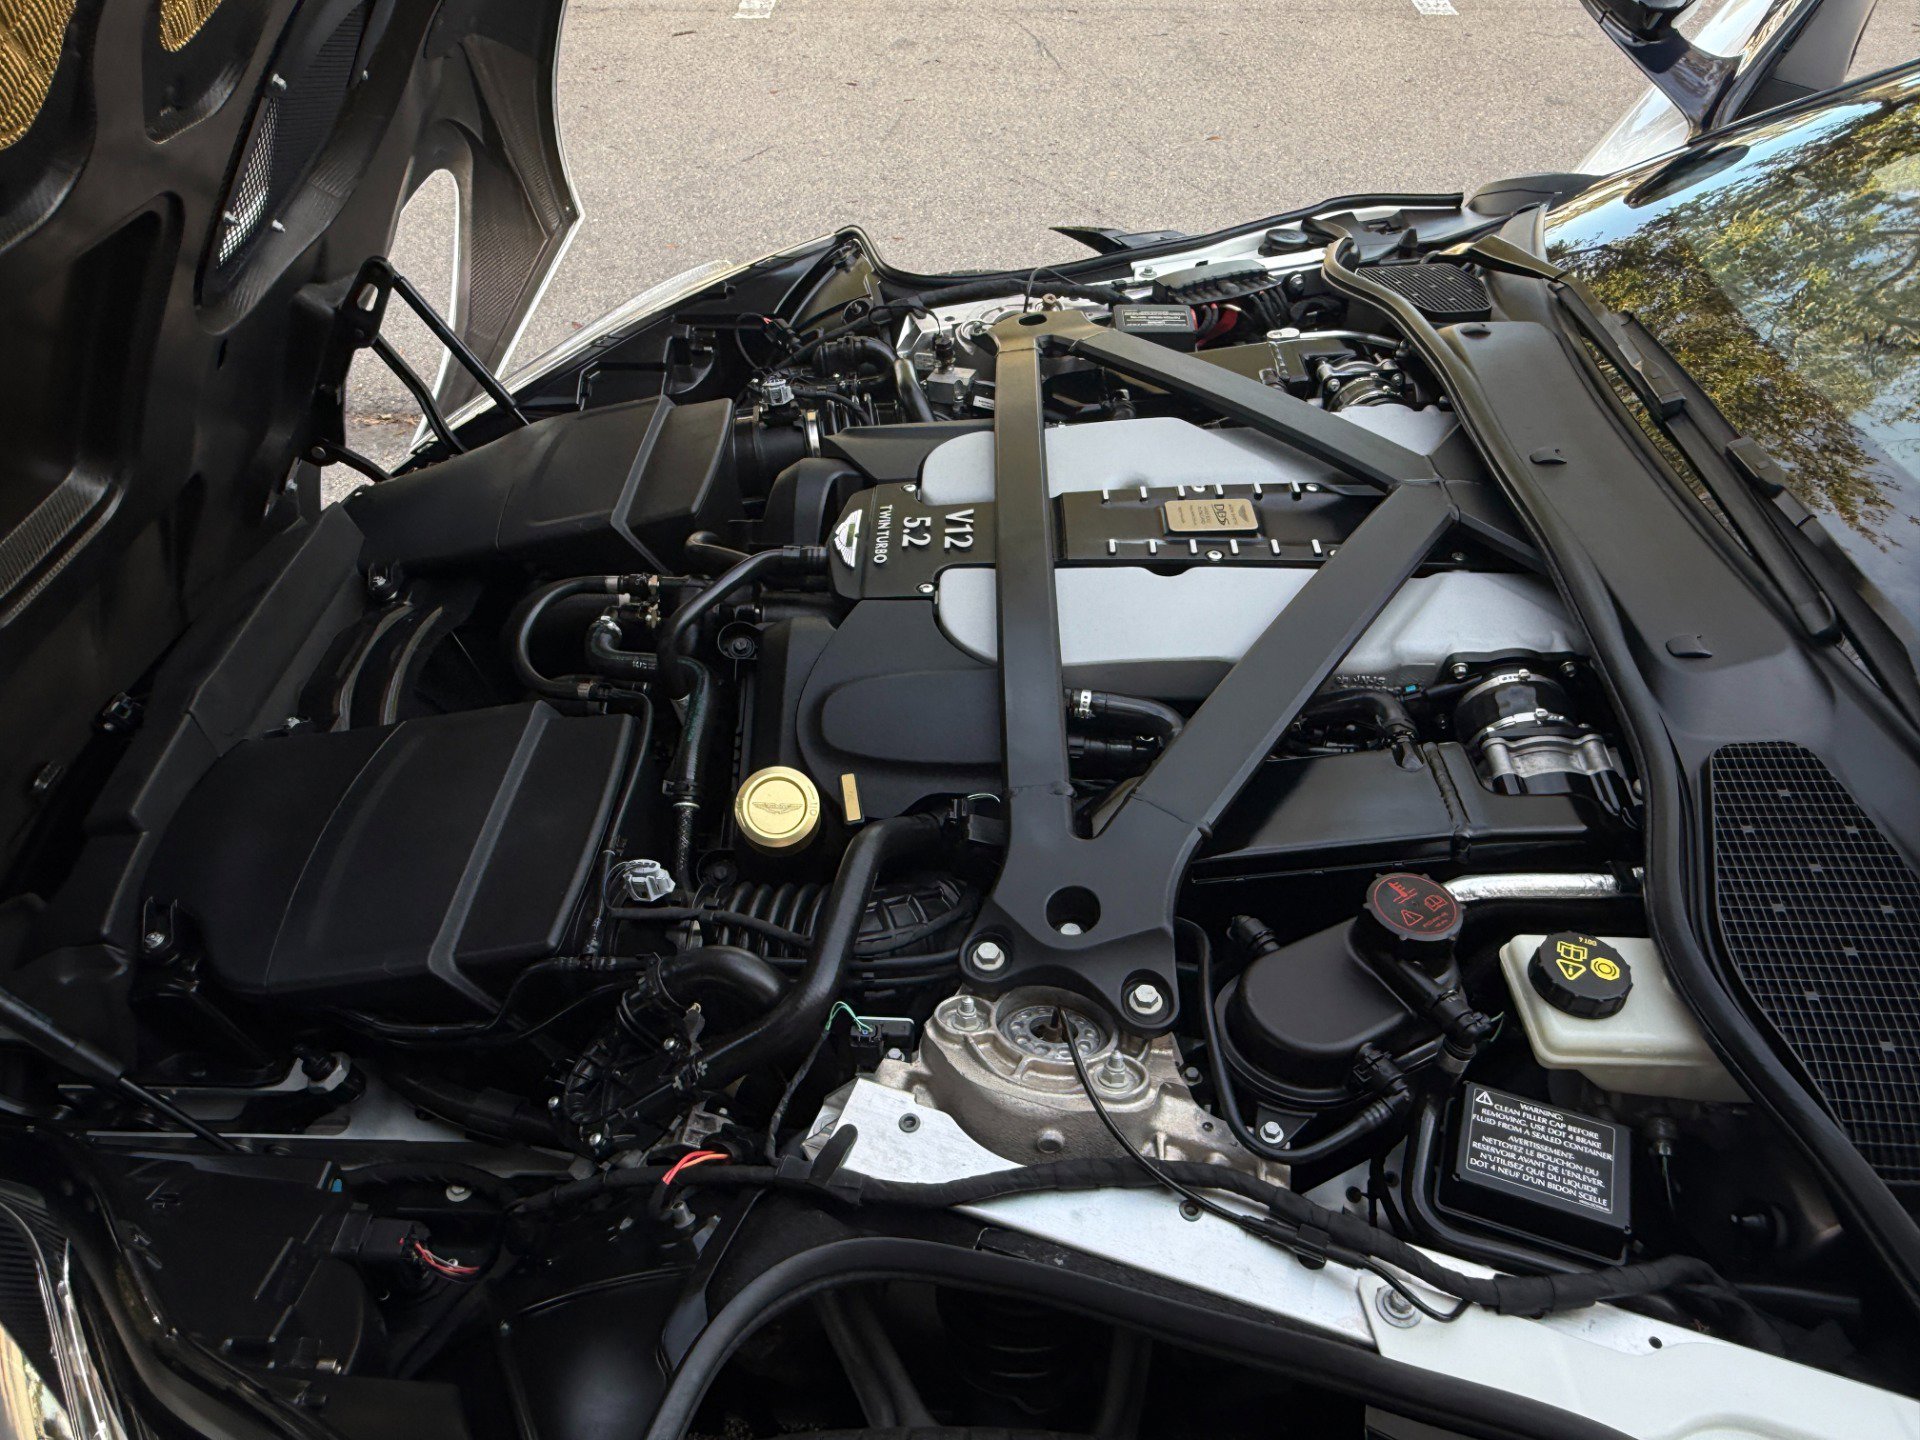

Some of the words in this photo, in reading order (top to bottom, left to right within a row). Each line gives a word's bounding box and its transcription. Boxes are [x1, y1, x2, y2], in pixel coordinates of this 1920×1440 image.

[877, 504, 893, 529] TWIN
[901, 516, 931, 548] 5.2
[944, 508, 975, 549] V12
[873, 530, 890, 564] TURBO
[1472, 1113, 1496, 1125] FLUID
[1497, 1121, 1522, 1133] FROM
[1531, 1131, 1562, 1145] SEALED
[1494, 1104, 1521, 1116] CLEAN
[1522, 1112, 1548, 1124] FILLER
[1549, 1120, 1566, 1130] CAP
[1568, 1125, 1599, 1140] BEFORE
[1530, 1122, 1545, 1133] USE
[1548, 1127, 1566, 1138] DOT
[1575, 1136, 1602, 1149] BRAKE
[1472, 1141, 1516, 1160] RESERVOIR
[1518, 1155, 1546, 1169] AVANT
[1547, 1164, 1560, 1174] DE
[1482, 1135, 1524, 1154] NETTOYEZ
[1525, 1148, 1534, 1157] LE
[1536, 1152, 1583, 1172] BOUCHON
[1585, 1167, 1599, 1177] DU
[1470, 1157, 1489, 1169] DOT
[1497, 1166, 1520, 1179] NEUF
[1522, 1173, 1546, 1187] D'UN
[1547, 1181, 1577, 1197] BIDON
[1480, 1152, 1524, 1171] N'UTILISEZ
[1526, 1166, 1545, 1178] QUE
[1546, 1172, 1561, 1182] DU
[1562, 1177, 1599, 1195] LIQUIDE
